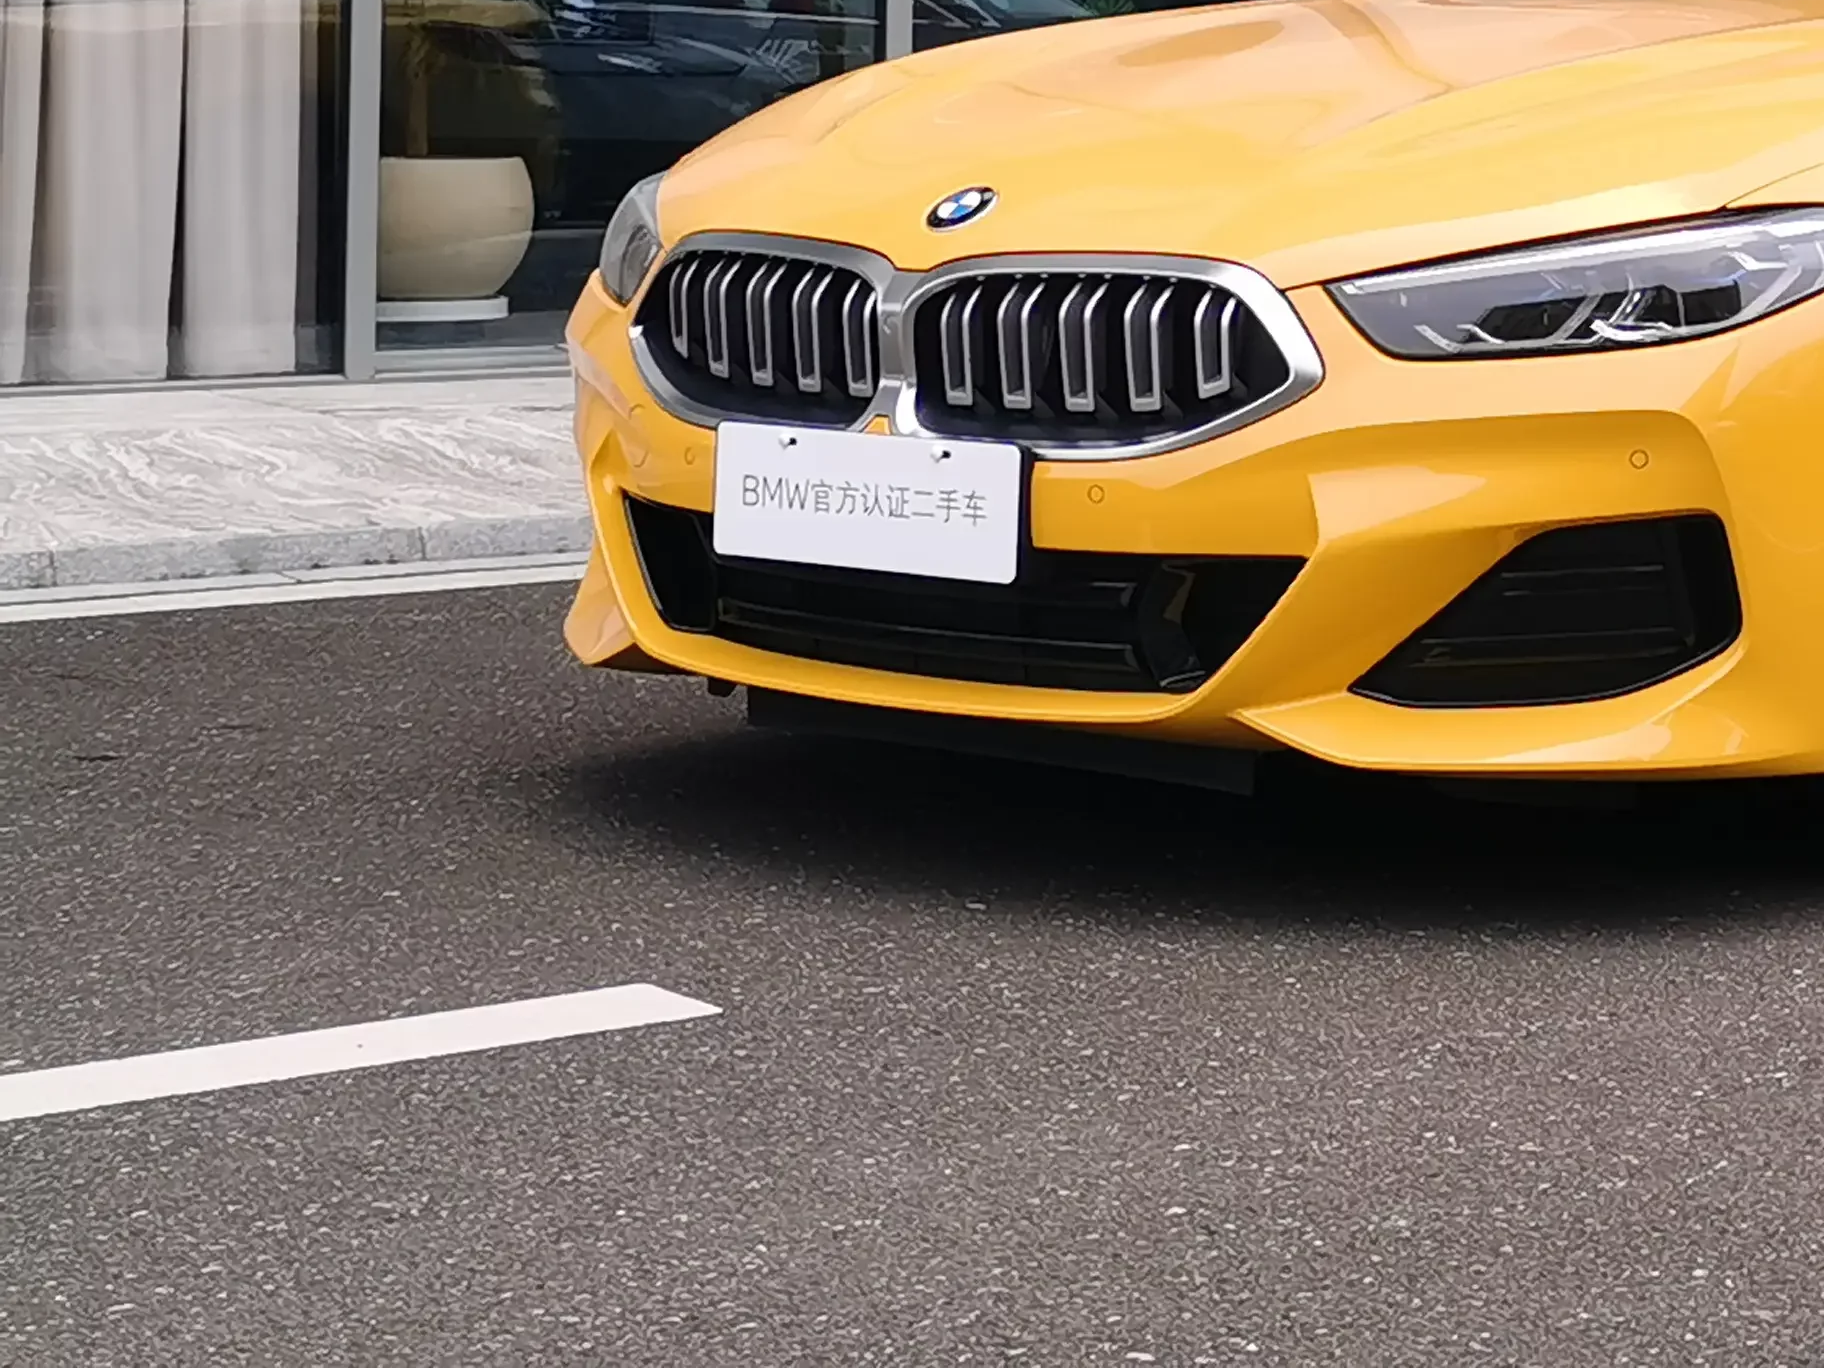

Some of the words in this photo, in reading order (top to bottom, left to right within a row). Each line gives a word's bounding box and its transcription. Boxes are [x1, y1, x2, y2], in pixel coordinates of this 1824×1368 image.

[741, 474, 988, 527] BMW官方认证二手车
